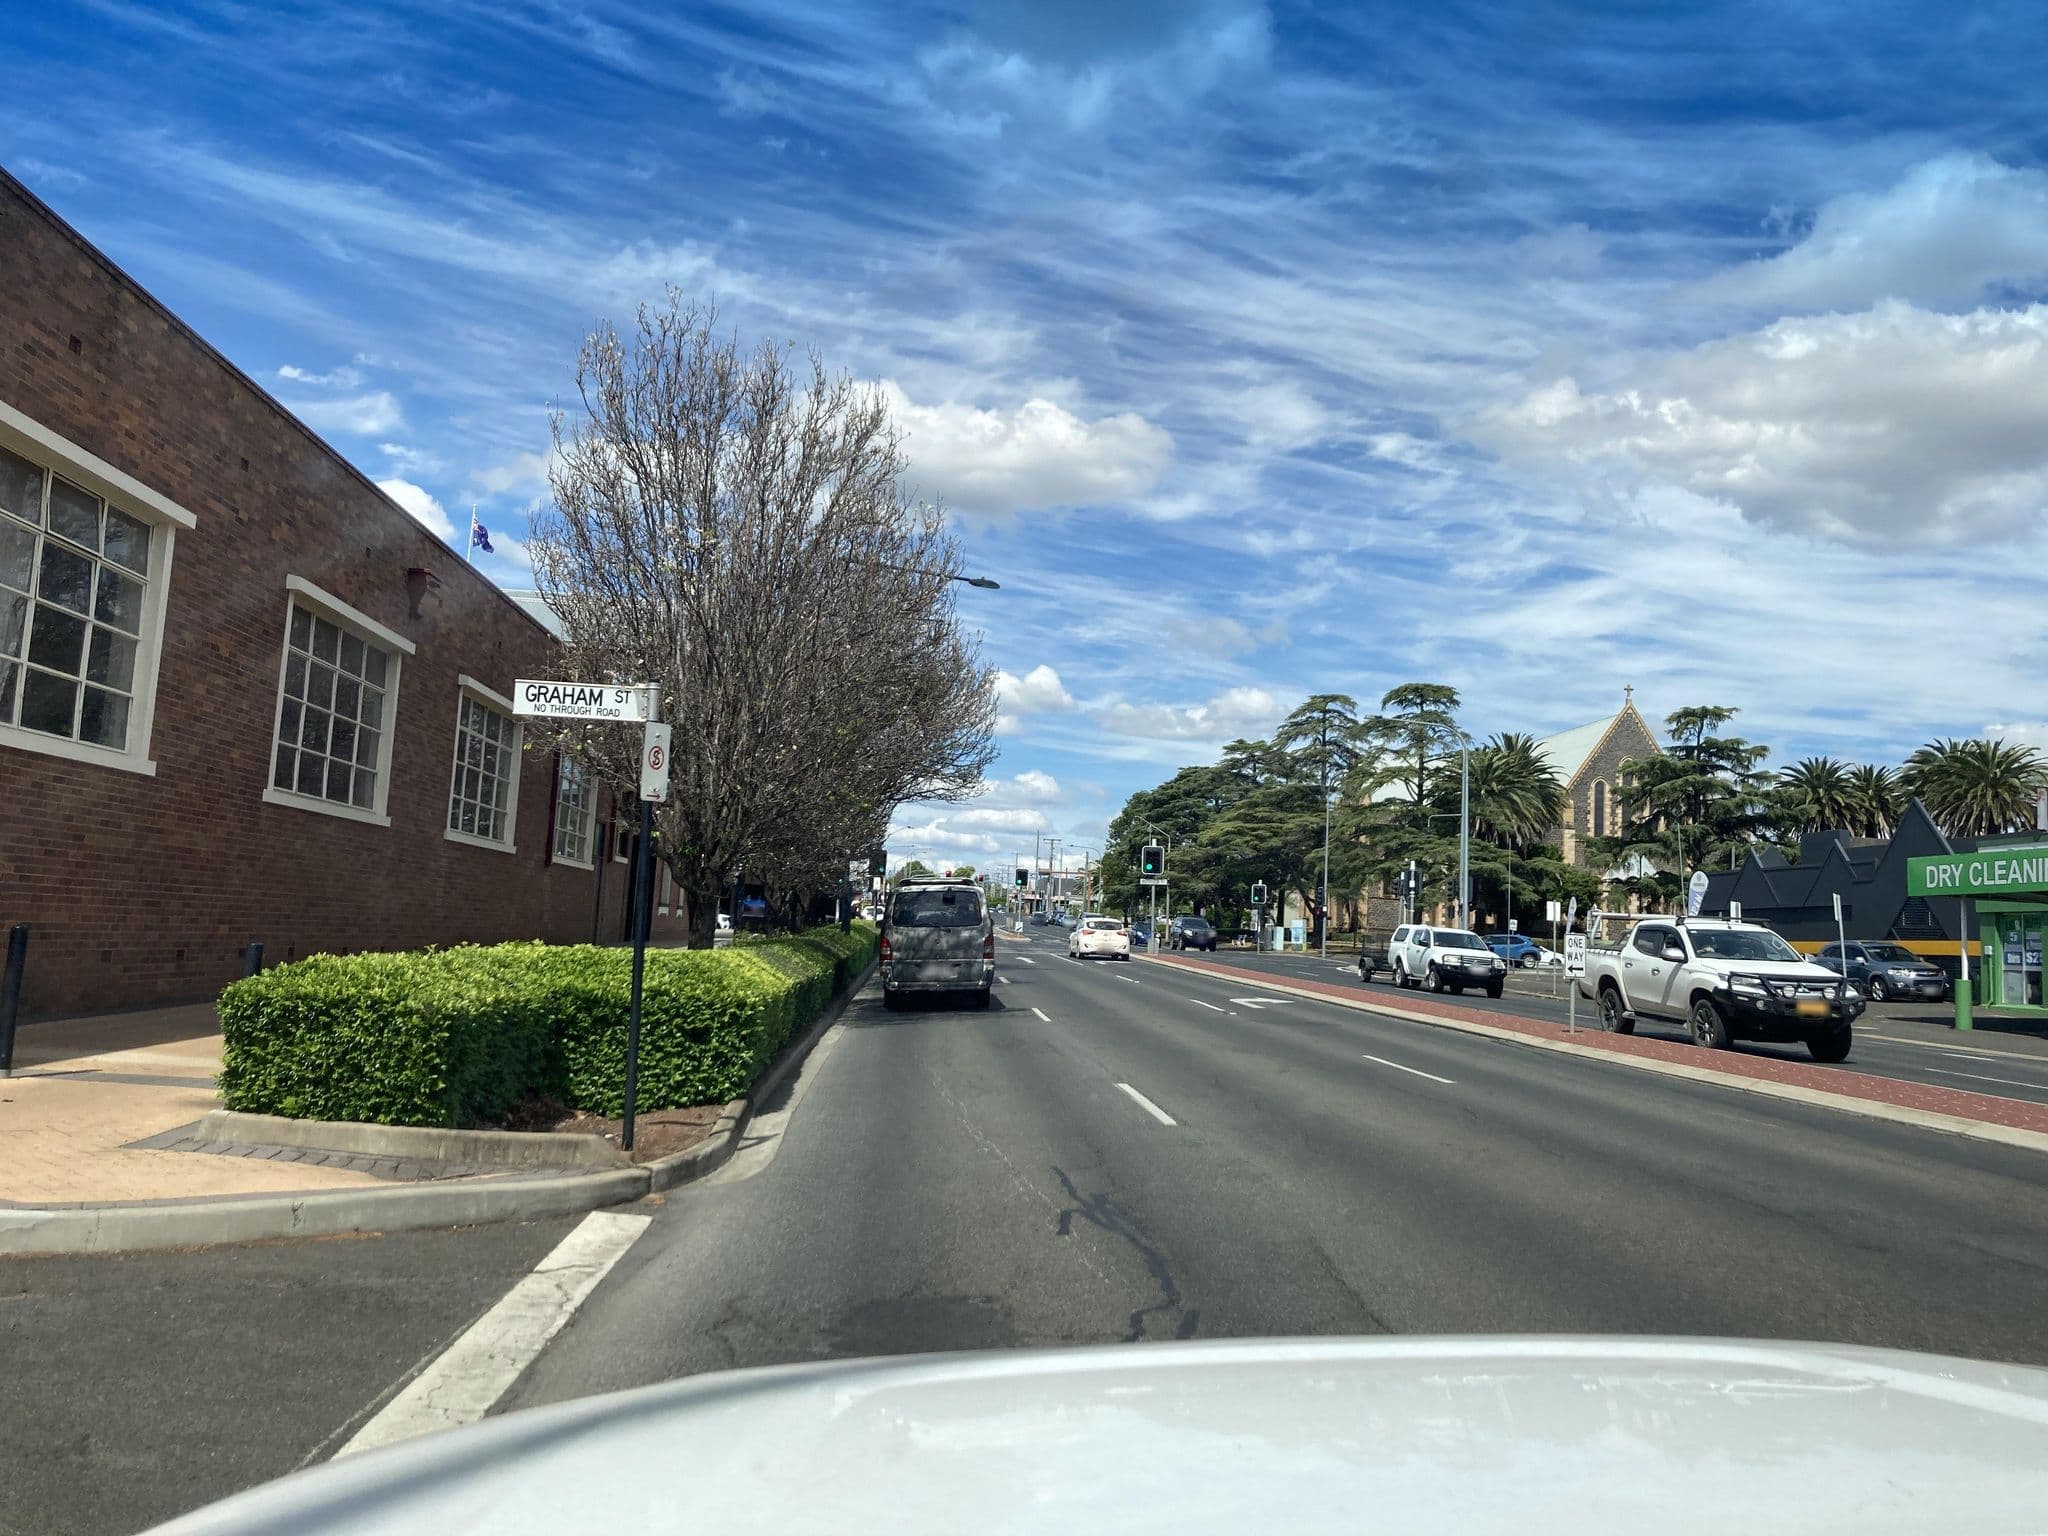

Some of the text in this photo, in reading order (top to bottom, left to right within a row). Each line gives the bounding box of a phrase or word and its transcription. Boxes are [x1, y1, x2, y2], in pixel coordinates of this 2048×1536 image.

[525, 684, 632, 707] GRAHAM ST
[533, 703, 621, 718] NO THROUGH ROAD
[1926, 863, 1963, 889] DRY
[1567, 937, 1583, 949] ONE
[1567, 952, 1584, 962] WAY
